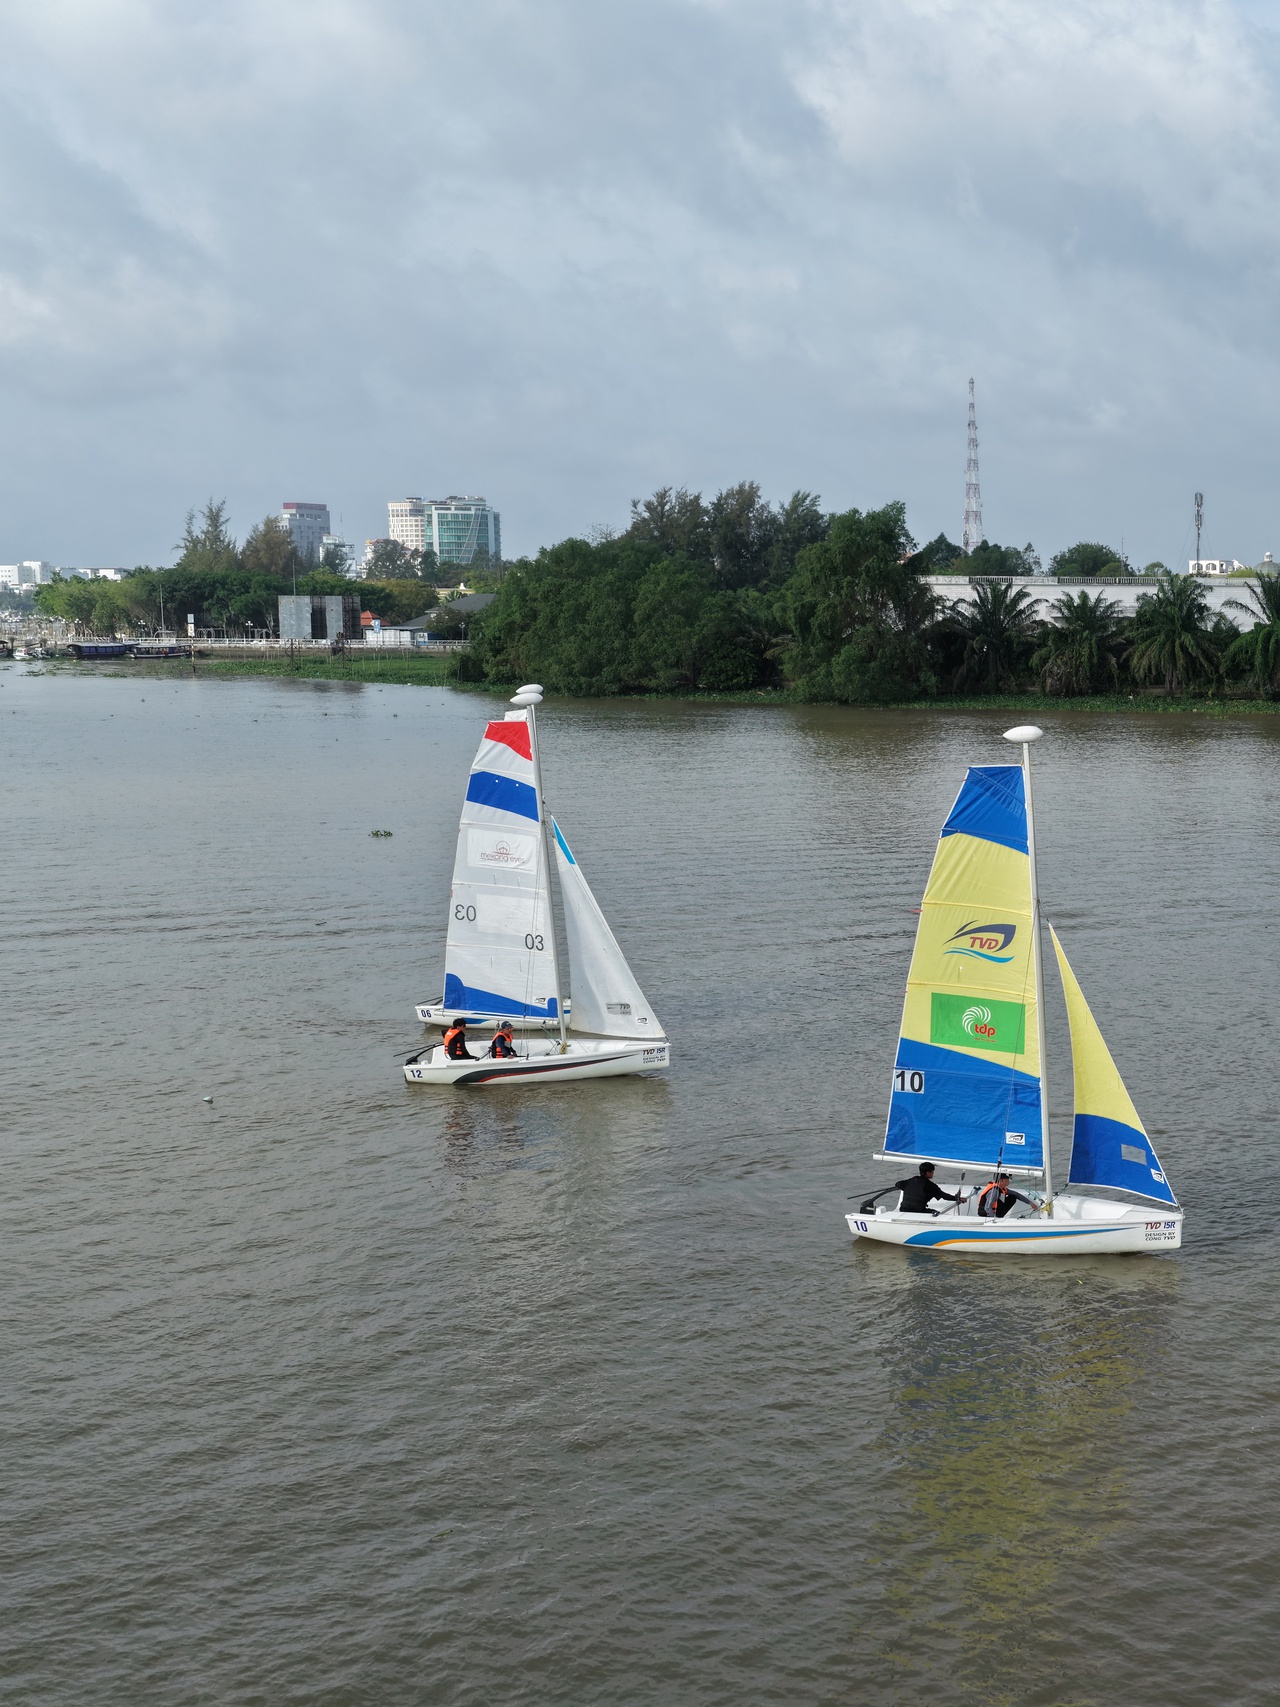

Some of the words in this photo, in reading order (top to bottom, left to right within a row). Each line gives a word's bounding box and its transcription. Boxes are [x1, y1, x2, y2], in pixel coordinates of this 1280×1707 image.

[481, 852, 508, 863] mekong
[510, 856, 526, 864] eyes
[525, 933, 544, 951] 03
[970, 936, 1000, 950] TVD
[421, 1010, 432, 1018] 06
[974, 1023, 997, 1037] tdp
[410, 1070, 423, 1078] 12
[896, 1070, 923, 1092] 10
[854, 1220, 868, 1232] 10
[1145, 1222, 1161, 1230] TVD
